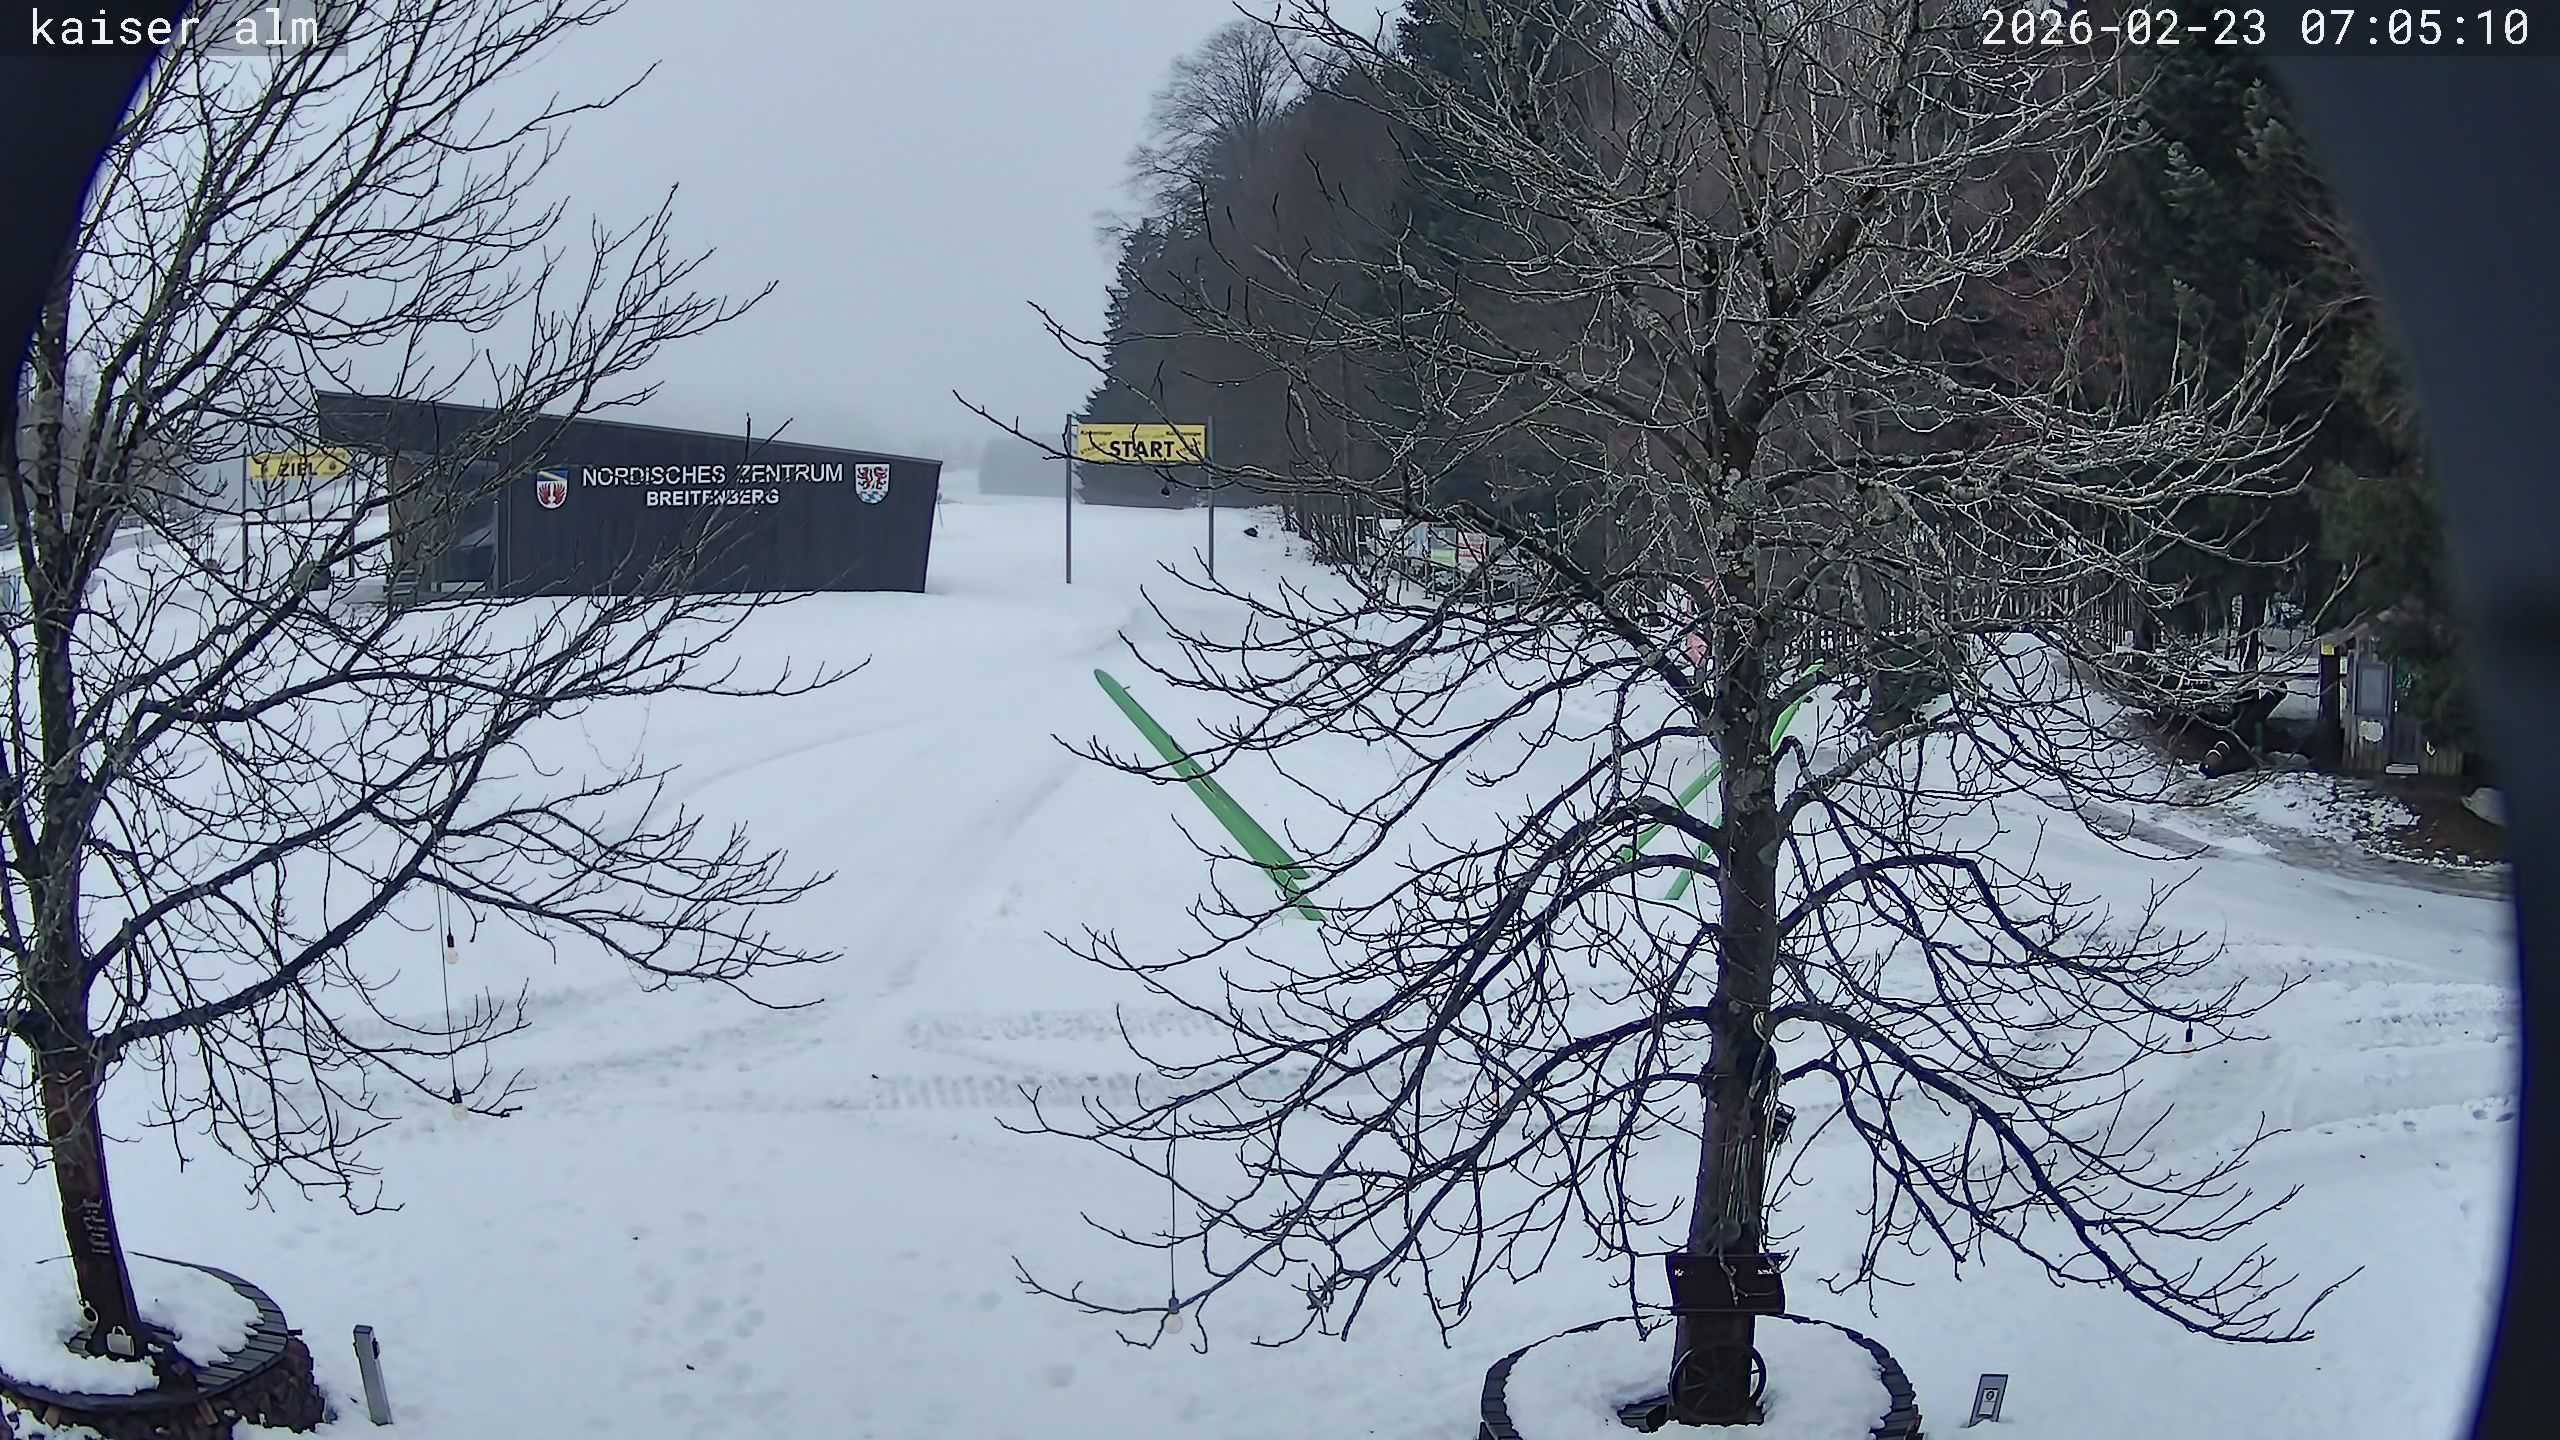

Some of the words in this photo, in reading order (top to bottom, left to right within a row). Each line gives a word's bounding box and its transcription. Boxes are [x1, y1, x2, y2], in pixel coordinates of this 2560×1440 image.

[1109, 440, 1175, 458] START
[279, 462, 318, 477] ZIEL
[582, 464, 727, 488] NORDISCHES
[736, 463, 844, 483] ZENTRUM
[646, 488, 780, 507] BREITENBERG
